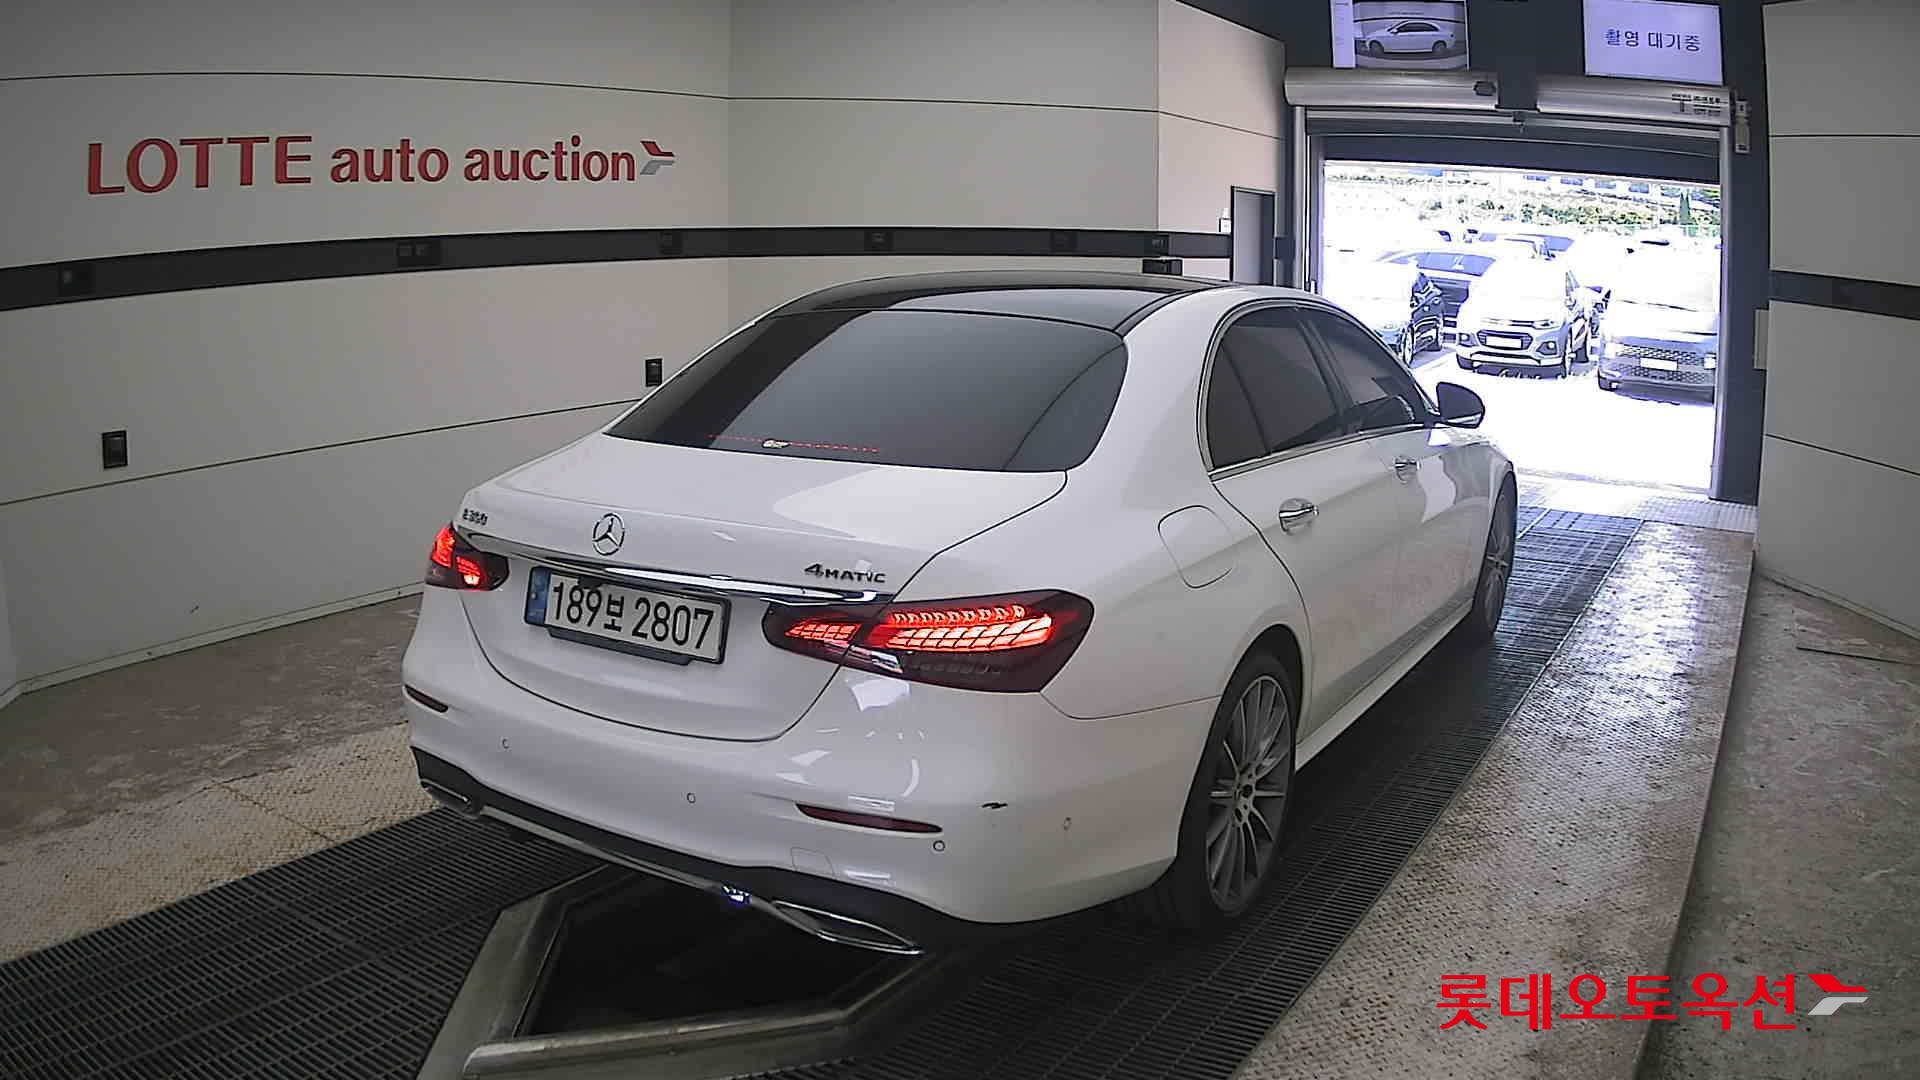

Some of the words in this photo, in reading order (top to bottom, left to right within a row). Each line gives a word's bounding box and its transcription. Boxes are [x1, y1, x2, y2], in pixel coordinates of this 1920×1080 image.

[1604, 28, 1639, 48] 촬영
[1647, 31, 1701, 52] 대기중
[87, 135, 313, 195] LOTTE
[330, 138, 449, 184] auto
[463, 135, 637, 183] auction
[804, 563, 886, 583] 4MATIC
[553, 580, 625, 633] 189보
[631, 596, 715, 650] 2807
